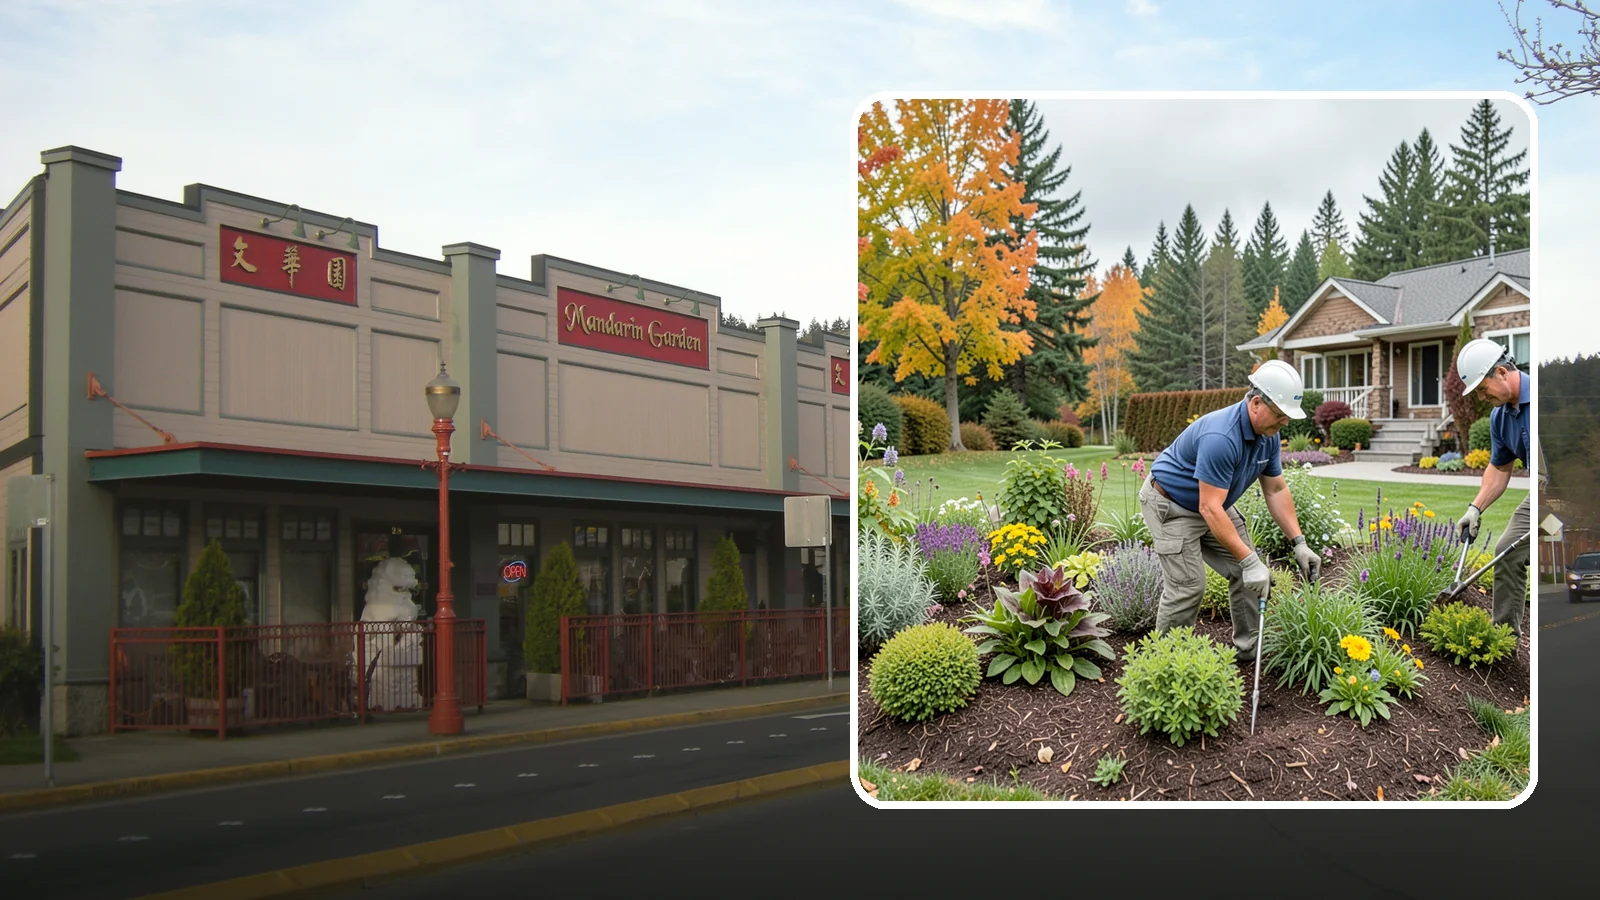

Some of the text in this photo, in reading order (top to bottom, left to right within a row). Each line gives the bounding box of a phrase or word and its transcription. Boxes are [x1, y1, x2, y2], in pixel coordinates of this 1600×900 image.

[565, 302, 701, 352] Mandarin Garden
[503, 565, 527, 578] OPEN
